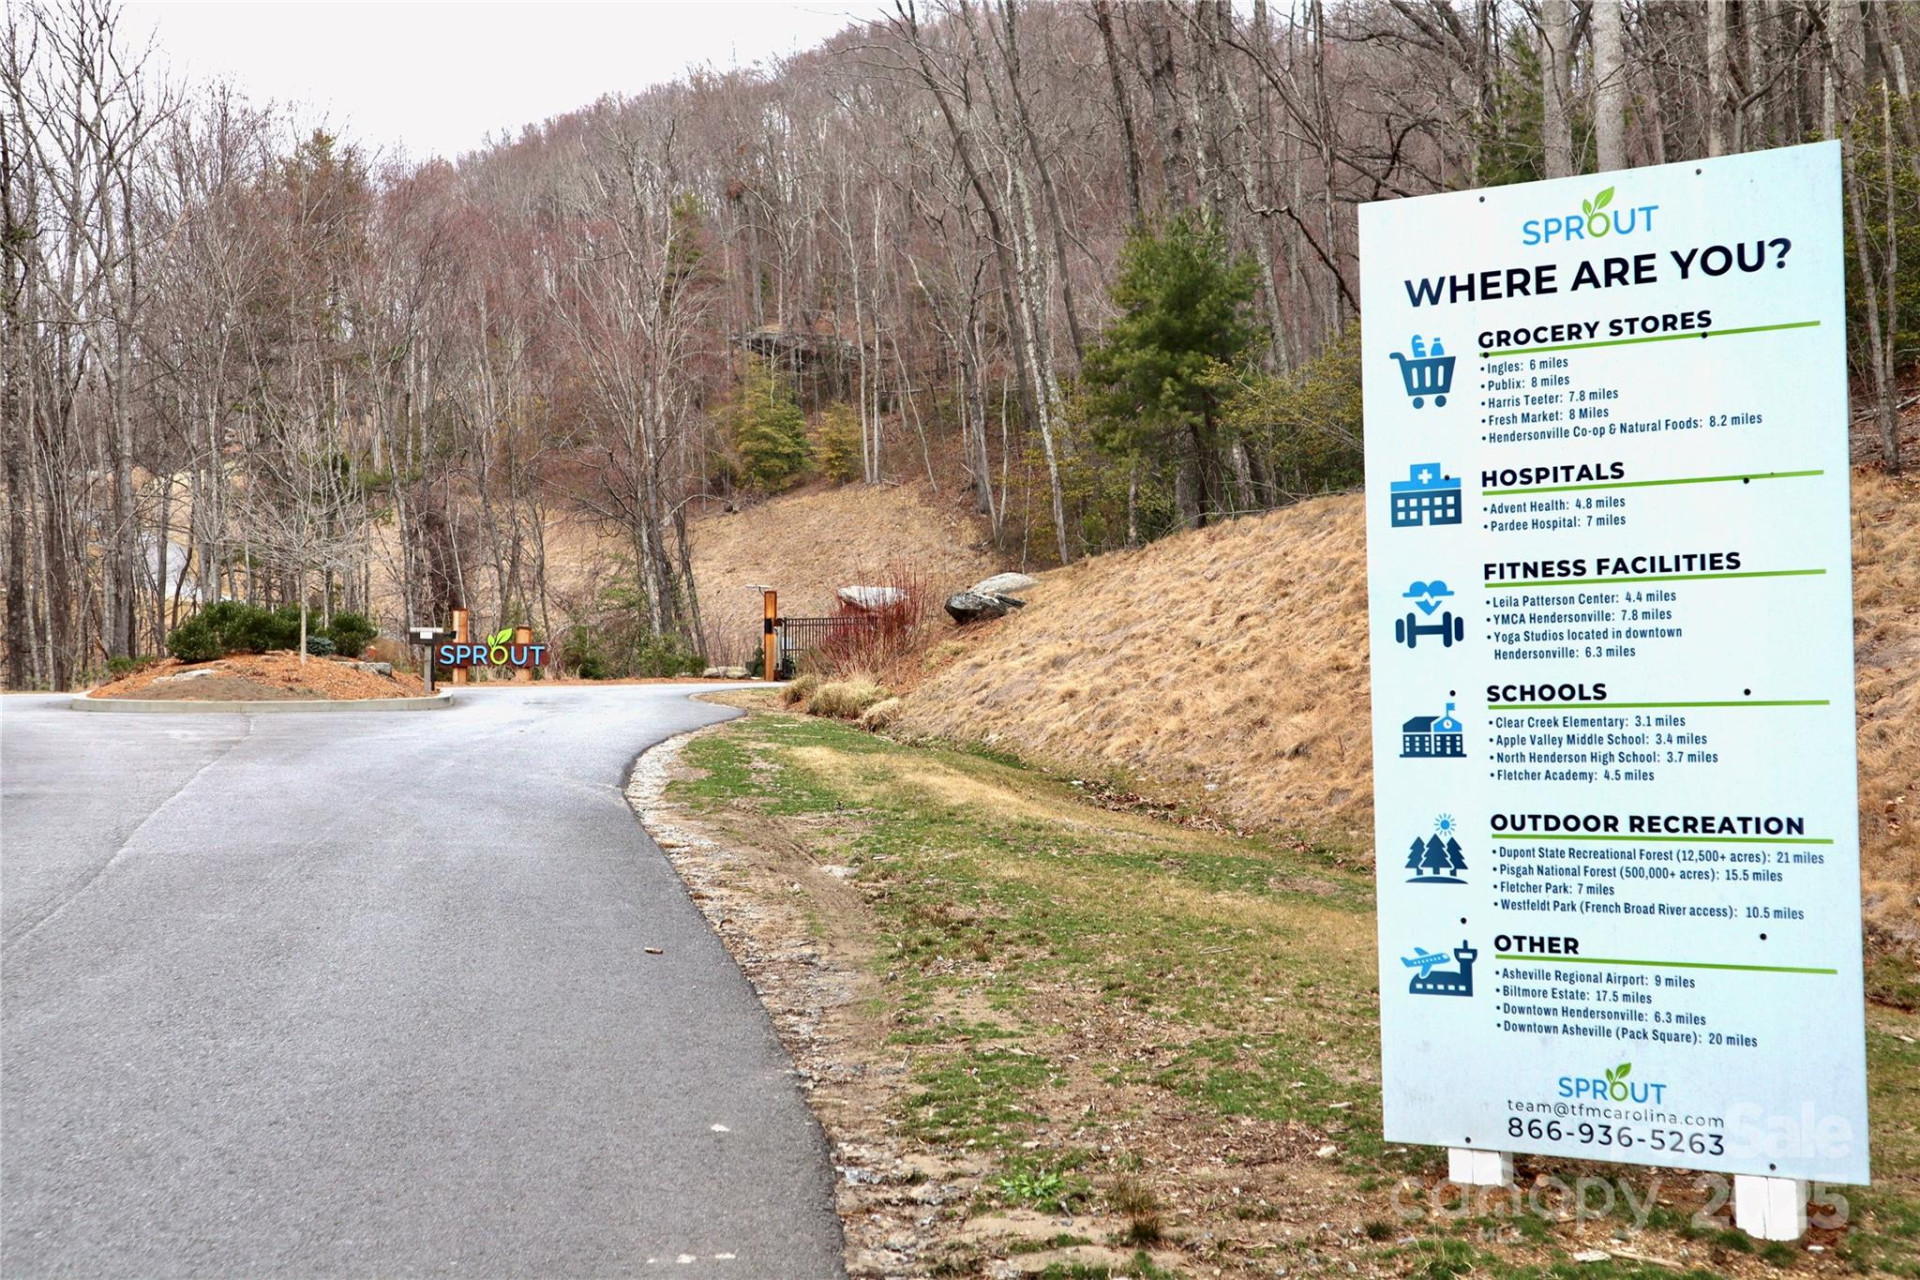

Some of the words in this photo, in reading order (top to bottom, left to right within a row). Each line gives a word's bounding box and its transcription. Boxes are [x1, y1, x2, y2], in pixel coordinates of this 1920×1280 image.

[1522, 202, 1659, 246] SPROUT
[1403, 263, 1558, 308] WHERE
[1569, 252, 1657, 292] ARE
[1669, 237, 1792, 280] YOU?
[1477, 320, 1600, 352] GROCERY
[1608, 309, 1712, 337] STORES
[1487, 360, 1524, 376] Ingles:
[1529, 358, 1536, 371] 6
[1538, 356, 1569, 370] miles
[1487, 377, 1525, 391] Publix:
[1530, 376, 1538, 388] 8
[1540, 374, 1570, 387] miles
[1487, 395, 1521, 409] Harris
[1522, 392, 1563, 406] Teeter:
[1568, 389, 1586, 402] 7.8
[1588, 387, 1619, 401] miles
[1488, 412, 1518, 426] Fresh
[1520, 409, 1563, 423] Market:
[1568, 408, 1575, 420] 8
[1578, 406, 1609, 419] Miles
[1488, 426, 1570, 443] Hendersonville
[1572, 425, 1606, 438] Co-op
[1608, 422, 1617, 435] &
[1619, 419, 1661, 434] Natural
[1664, 416, 1702, 431] Foods:
[1709, 414, 1727, 428] 8.2
[1730, 412, 1762, 426] miles
[1481, 461, 1625, 488] HOSPITALS
[1489, 501, 1527, 514] Advent
[1529, 498, 1569, 512] Health:
[1574, 497, 1593, 509] 4.8
[1595, 495, 1625, 508] miles
[1490, 519, 1528, 532] Pardee
[1531, 515, 1581, 531] Hospital:
[1586, 514, 1593, 527] 7
[1595, 513, 1626, 526] miles
[1483, 558, 1587, 581] FITNESS
[1595, 551, 1741, 576] FACILITIES
[1492, 595, 1519, 608] Leila
[1521, 595, 1575, 607] Patterson
[1577, 592, 1619, 605] Center:
[1624, 590, 1642, 603] 4.4
[1645, 589, 1676, 602] miles
[1492, 612, 1526, 625] YMCA
[1528, 609, 1615, 624] Hendersonville:
[1621, 608, 1638, 621] 7.8
[1640, 607, 1672, 620] miles
[1493, 631, 1521, 645] Yoga
[1523, 629, 1564, 642] Studios
[1566, 627, 1609, 641] located
[1611, 627, 1622, 639] in
[1624, 626, 1682, 639] downtown
[440, 645, 546, 665] SPROUT
[1493, 646, 1579, 660] Hendersonville:
[1584, 645, 1602, 658] 6.3
[1605, 644, 1635, 657] miles
[1486, 682, 1607, 703] SCHOOLS
[1495, 716, 1525, 728] Clear
[1526, 715, 1559, 728] Creek
[1562, 715, 1628, 730] Elementary:
[1634, 715, 1652, 727] 3.1
[1654, 714, 1686, 727] miles
[1495, 733, 1526, 748] Apple
[1529, 733, 1563, 748] Valley
[1565, 732, 1604, 745] Middle
[1606, 732, 1649, 745] School:
[1655, 732, 1673, 745] 3.4
[1676, 732, 1707, 745] miles
[1496, 751, 1526, 763] North
[1528, 751, 1587, 763] Henderson
[1589, 750, 1615, 766] High
[1617, 750, 1660, 763] School:
[1666, 750, 1684, 763] 3.7
[1686, 750, 1718, 763] miles
[1497, 768, 1541, 781] Fletcher
[1544, 768, 1597, 783] Academy:
[1603, 769, 1621, 781] 4.5
[1623, 768, 1655, 781] miles
[1489, 813, 1619, 833] OUTDOOR
[1628, 814, 1804, 835] RECREATION
[1499, 846, 1536, 860] Dupont
[1537, 846, 1566, 859] State
[1567, 846, 1636, 860] Recreational
[1638, 848, 1673, 861] Forest
[1675, 848, 1726, 863] (12,500+
[1729, 850, 1770, 865] acres):
[1776, 850, 1790, 863] 21
[1792, 851, 1824, 864] miles
[1499, 863, 1534, 878] Pisgah
[1536, 864, 1581, 877] National
[1582, 864, 1616, 878] Forest
[1619, 865, 1676, 880] (500,000+
[1679, 867, 1719, 882] acres):
[1725, 868, 1749, 881] 15.5
[1751, 868, 1783, 882] miles
[1500, 880, 1543, 893] Fletcher
[1544, 881, 1572, 897] Park:
[1577, 882, 1584, 894] 7
[1585, 882, 1615, 896] miles
[1500, 898, 1550, 911] Westfeldt
[1552, 899, 1577, 912] Park
[1579, 900, 1621, 915] (French
[1623, 901, 1655, 915] Broad
[1657, 902, 1687, 916] River
[1688, 904, 1737, 920] access):
[1745, 906, 1770, 919] 10.5
[1772, 906, 1804, 920] miles
[1493, 933, 1579, 955] OTHER
[1501, 967, 1551, 981] Asheville
[1554, 969, 1602, 985] Regional
[1605, 972, 1648, 987] Airport:
[1653, 974, 1661, 986] 9
[1664, 975, 1695, 988] miles
[1502, 984, 1548, 999] Biltmore
[1550, 986, 1590, 1001] Estate:
[1595, 989, 1619, 1003] 17.5
[1621, 990, 1652, 1004] miles
[1502, 1001, 1558, 1017] Downtown
[1561, 1005, 1648, 1022] Hendersonville:
[1653, 1010, 1672, 1023] 6.3
[1675, 1012, 1706, 1026] miles
[1503, 1019, 1558, 1034] Downtown
[1561, 1023, 1612, 1038] Asheville
[1615, 1026, 1649, 1041] (Pack
[1651, 1028, 1702, 1045] Square):
[1707, 1031, 1723, 1045] 20
[1725, 1033, 1757, 1048] miles
[1558, 1075, 1667, 1105] SPROUT
[1507, 1099, 1724, 1128] team@tfmcarolina.com
[1507, 1115, 1724, 1156] 866-936-5263
